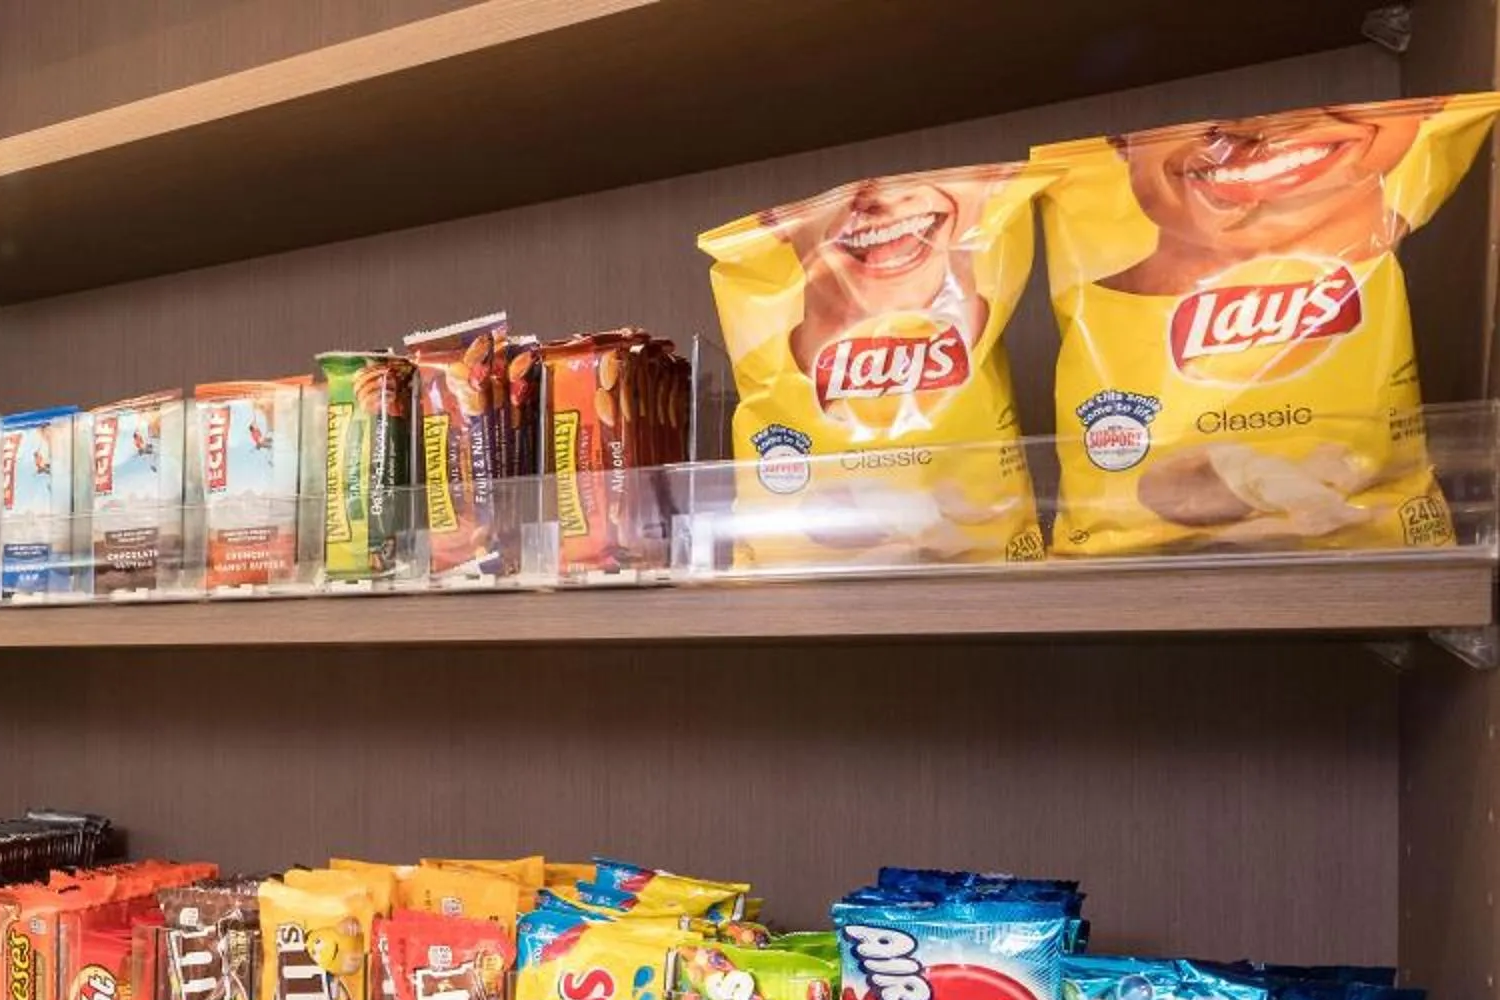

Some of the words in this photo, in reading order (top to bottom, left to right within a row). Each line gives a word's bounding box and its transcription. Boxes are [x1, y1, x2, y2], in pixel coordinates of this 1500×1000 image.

[1182, 274, 1347, 360] Lay's
[826, 330, 958, 400] Lay's
[425, 420, 446, 471] VALLEY
[472, 430, 485, 456] Nut
[554, 417, 577, 471] VALLEY
[1196, 405, 1312, 435] Classic
[609, 440, 626, 493] Almond
[840, 445, 933, 471] Classic
[427, 471, 455, 529] NATURE
[473, 472, 489, 504] Fruit
[556, 472, 583, 533] NATURE
